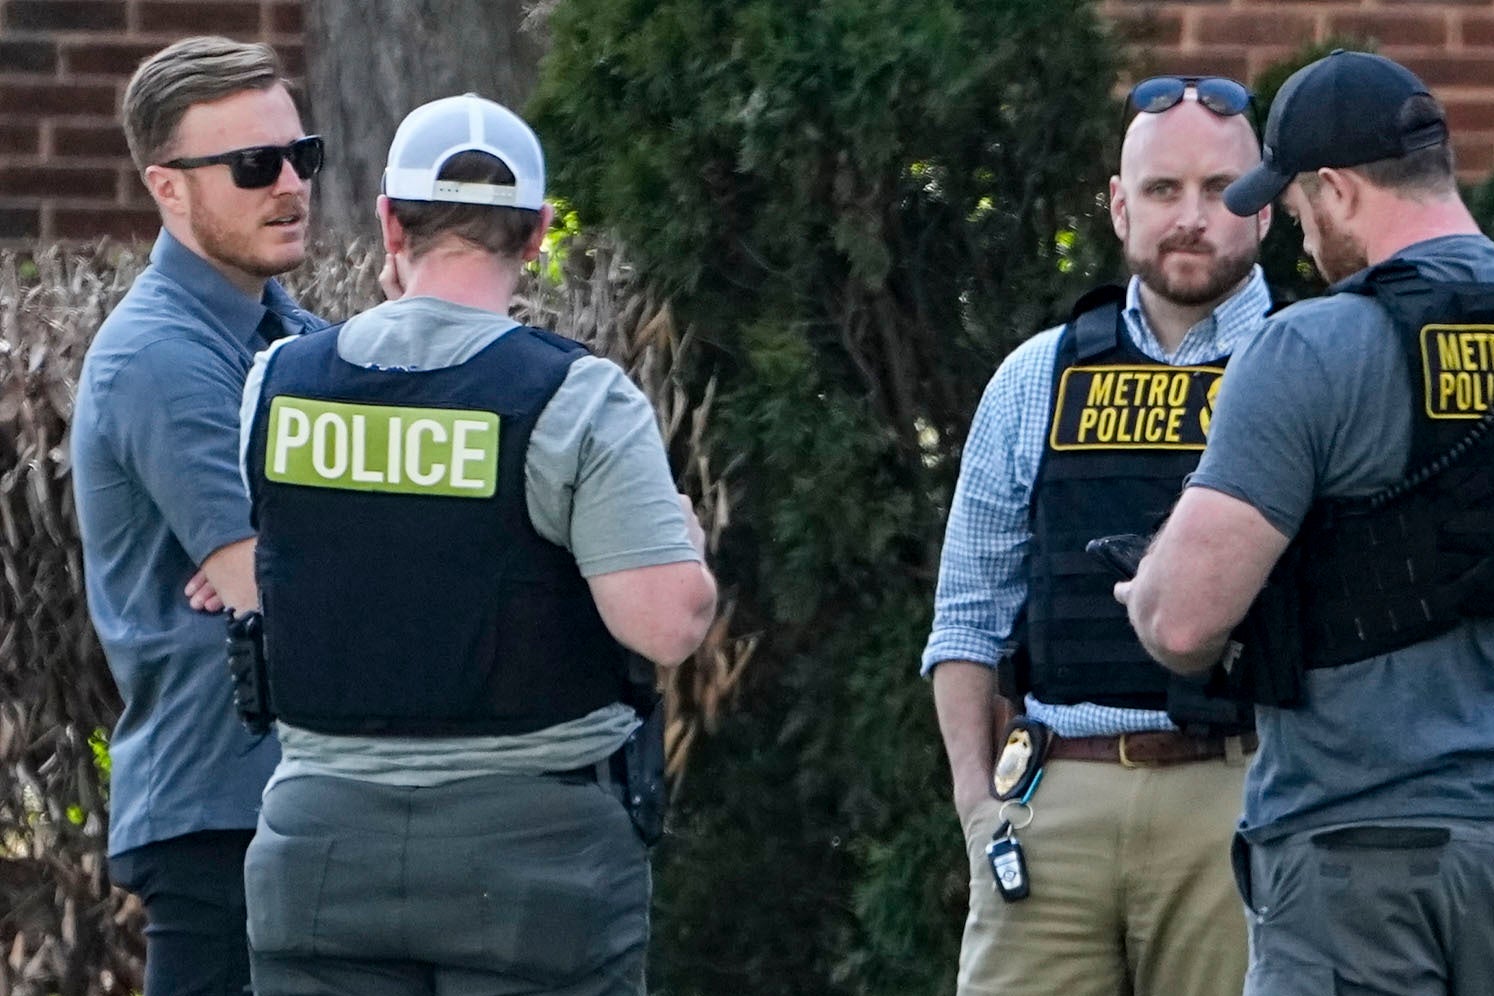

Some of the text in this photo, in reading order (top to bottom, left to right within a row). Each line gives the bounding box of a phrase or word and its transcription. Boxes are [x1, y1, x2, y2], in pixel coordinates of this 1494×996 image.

[1087, 372, 1190, 407] METRO
[1077, 407, 1187, 443] POLICE
[273, 406, 490, 488] POLICE
